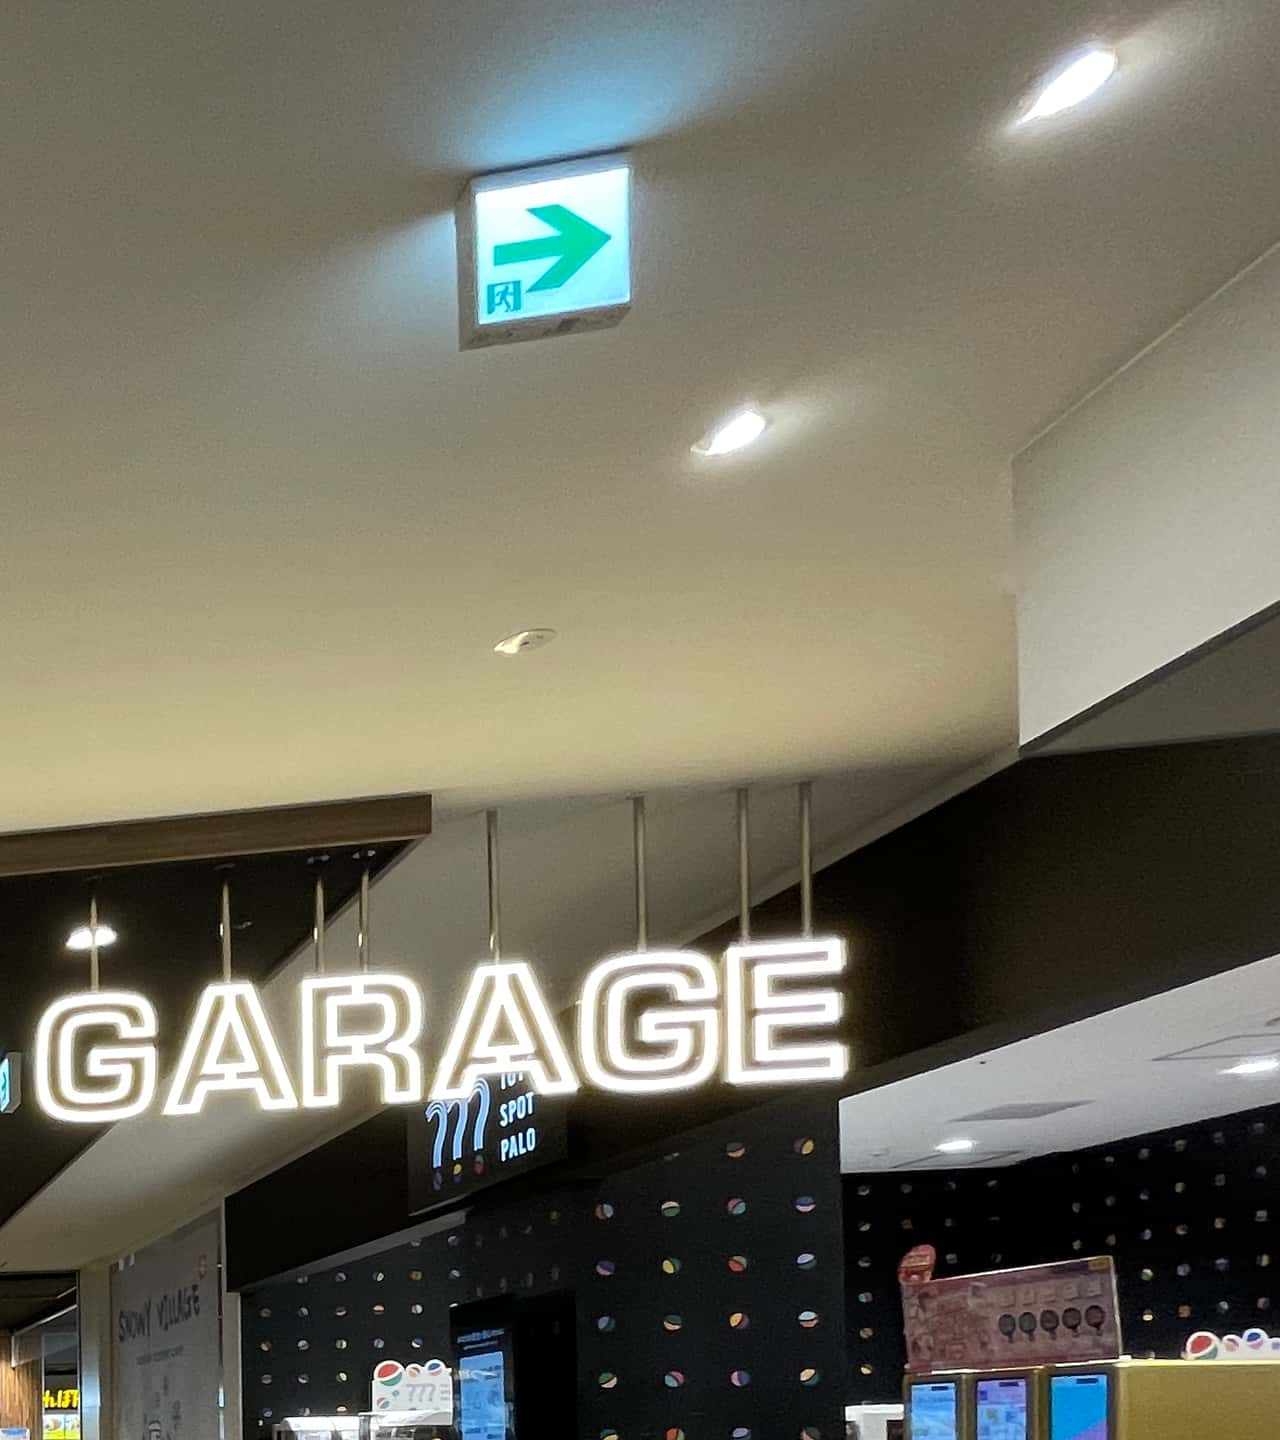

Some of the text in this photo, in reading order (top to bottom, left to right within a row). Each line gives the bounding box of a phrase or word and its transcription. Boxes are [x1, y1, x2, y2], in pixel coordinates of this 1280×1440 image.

[37, 938, 846, 1123] GARAGE
[500, 1092, 535, 1127] SPOT
[500, 1128, 536, 1162] PALO
